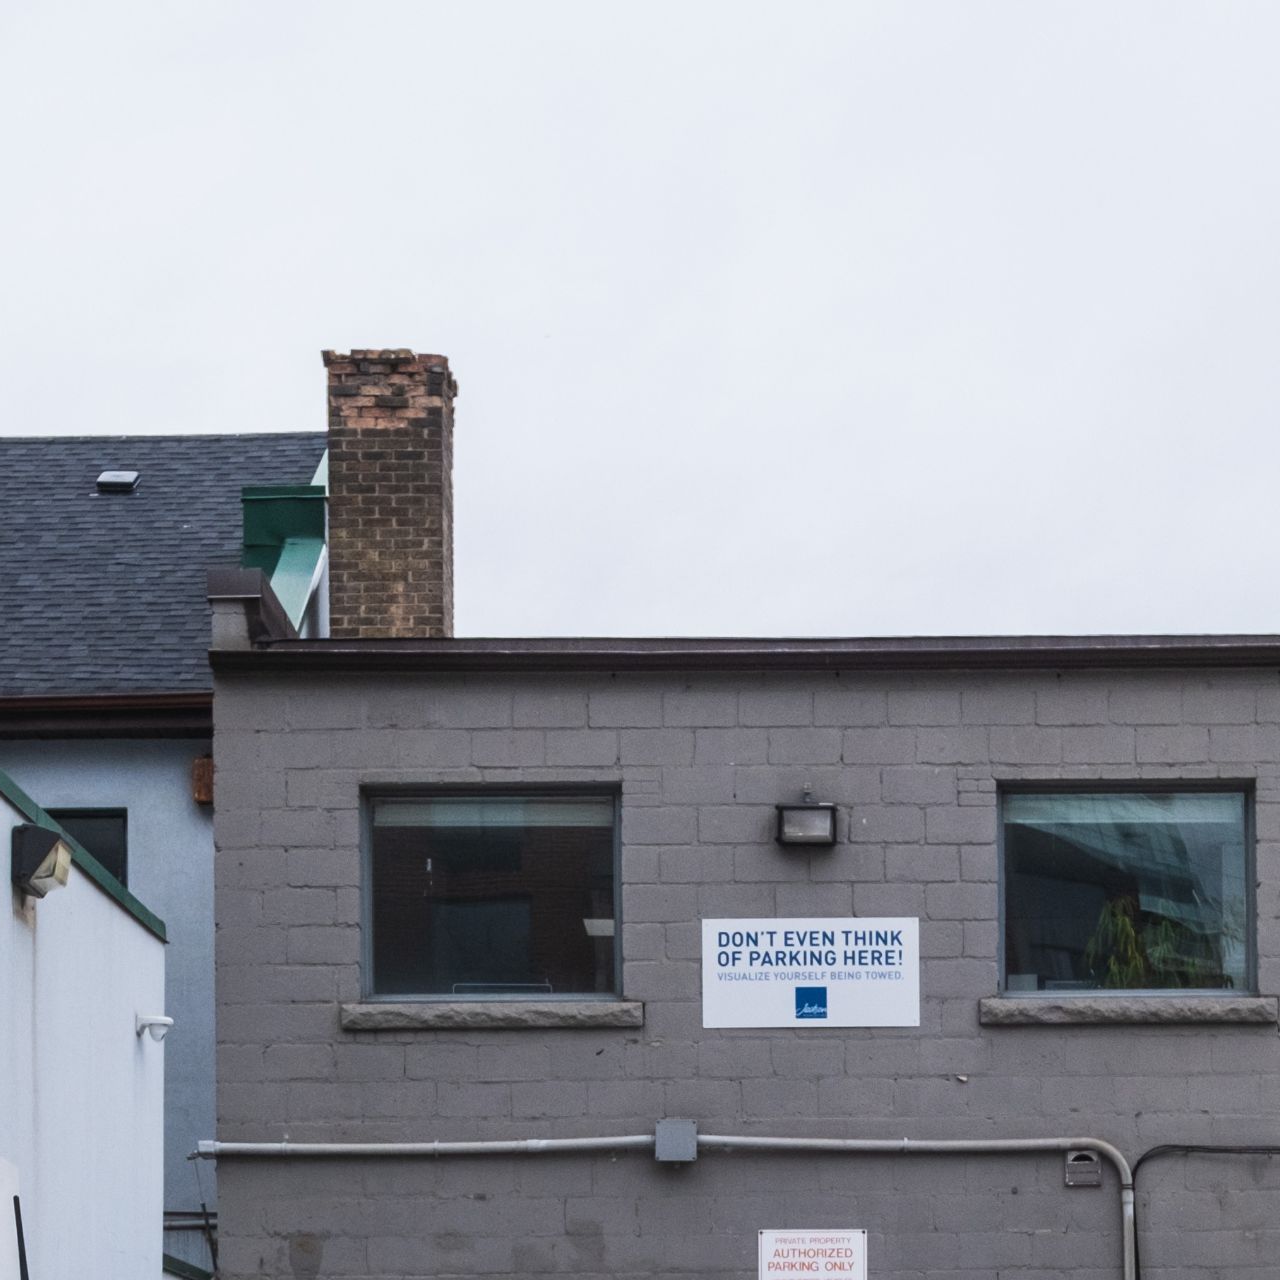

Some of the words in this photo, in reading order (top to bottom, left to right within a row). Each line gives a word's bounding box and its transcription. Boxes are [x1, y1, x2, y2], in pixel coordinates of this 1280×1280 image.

[718, 931, 777, 947] DON'T
[784, 931, 835, 947] EVEN
[841, 930, 903, 946] THINK
[717, 950, 742, 967] OF
[749, 950, 837, 967] PARKING
[843, 949, 903, 966] HERE!
[717, 972, 770, 981] VISUALIZE
[773, 971, 827, 981] YOURSELF
[830, 971, 862, 981] BEING
[865, 971, 904, 981] TOWED.
[775, 1237, 806, 1245] PRIVATE
[809, 1237, 851, 1245] PROPERTY
[773, 1248, 853, 1259] AUTHORIZED
[767, 1261, 819, 1272] PARKING
[824, 1261, 854, 1272] ONLY
